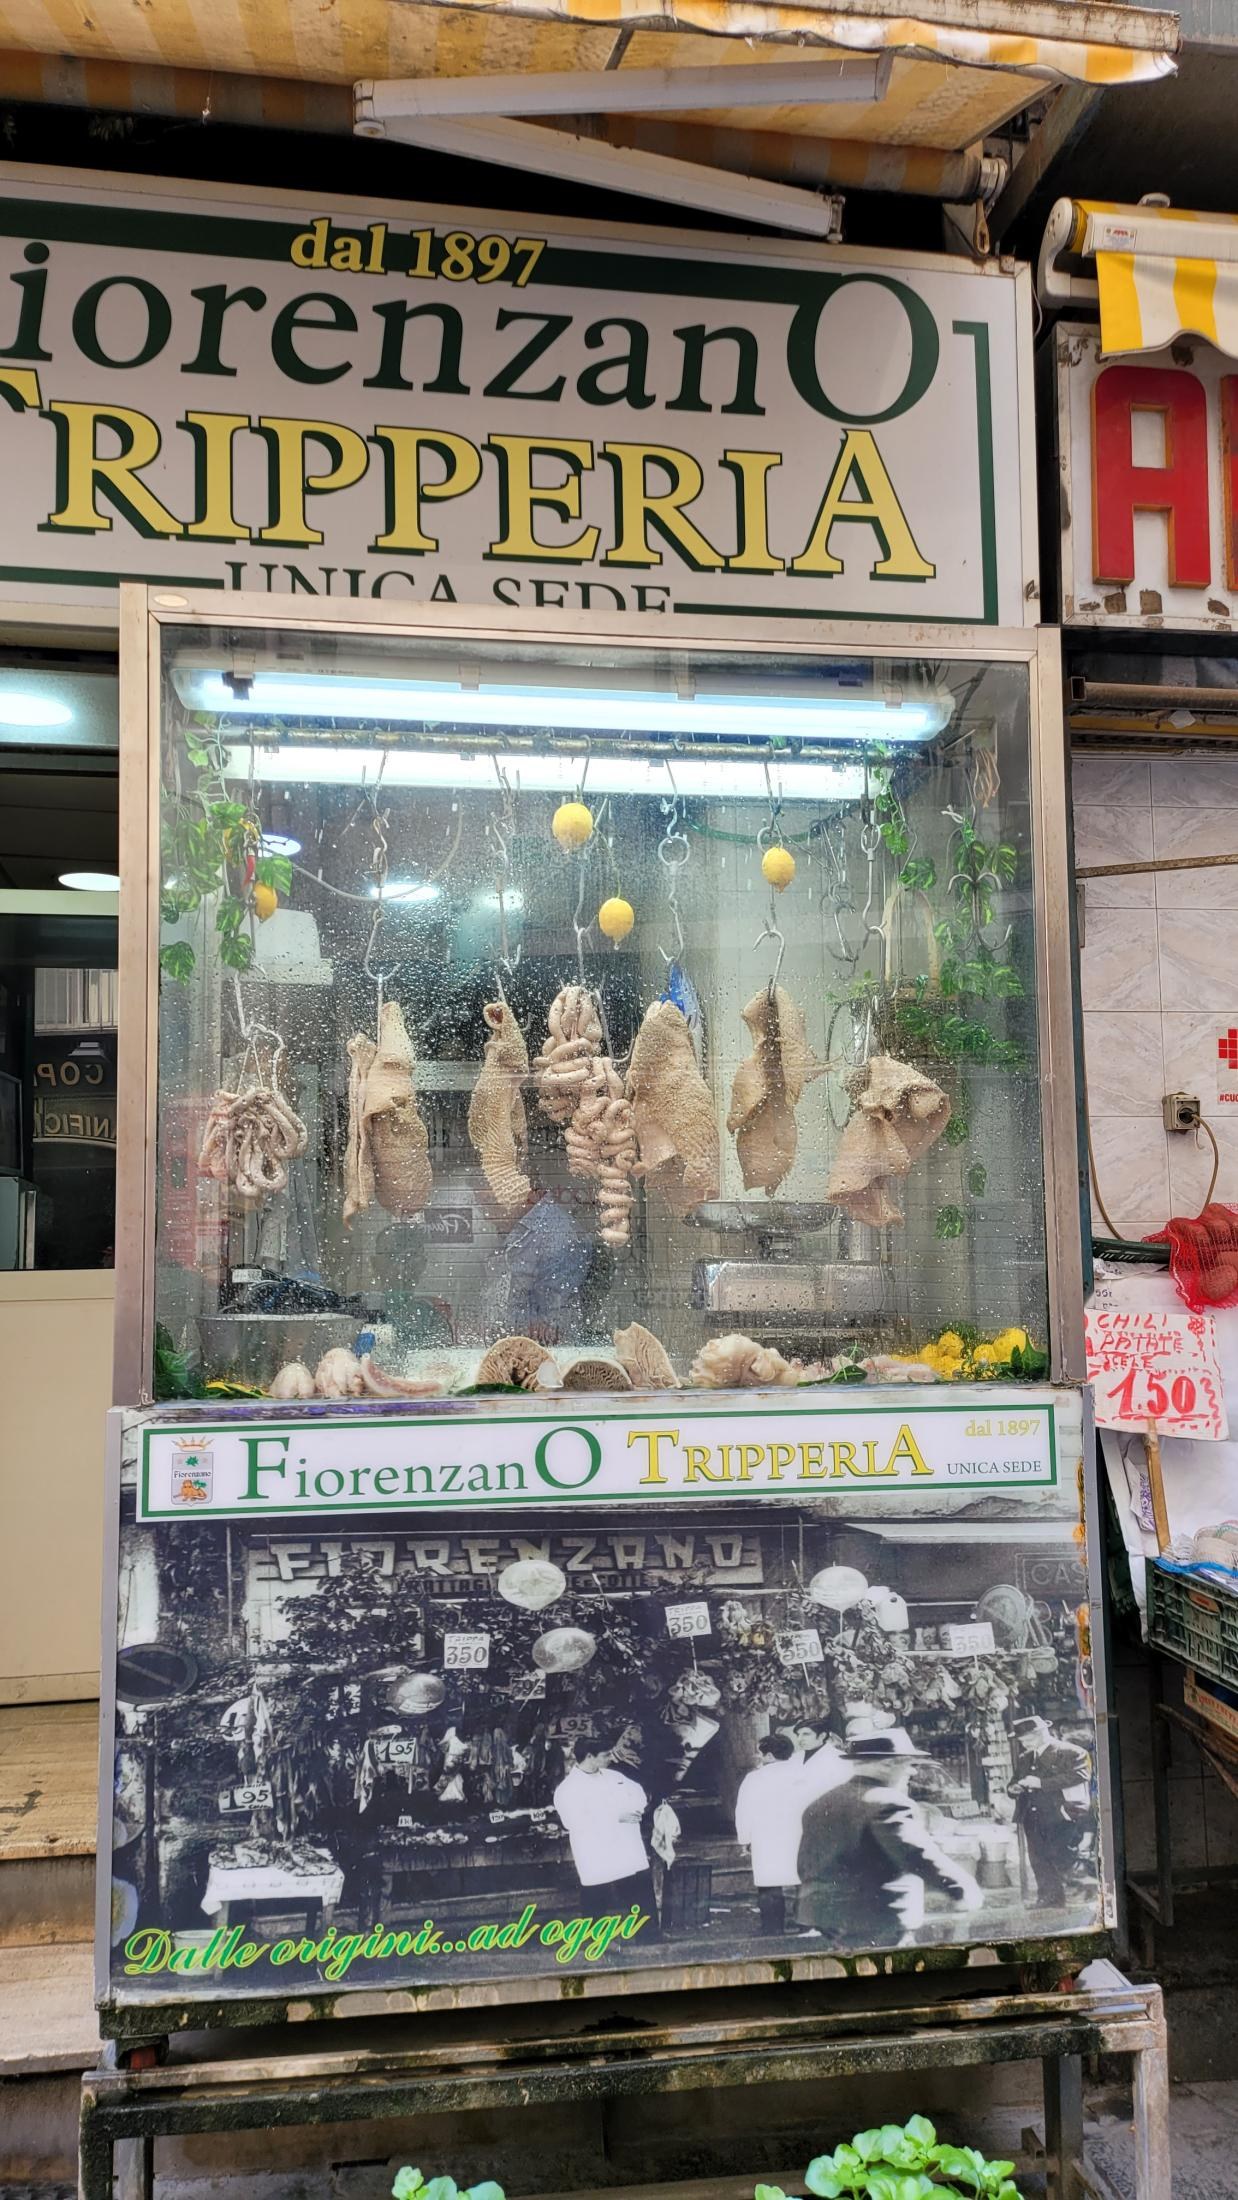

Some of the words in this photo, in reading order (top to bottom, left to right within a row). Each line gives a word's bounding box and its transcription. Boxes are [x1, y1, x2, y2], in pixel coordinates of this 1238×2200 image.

[290, 217, 389, 275] dal
[407, 228, 547, 288] 1897
[1106, 1369, 1197, 1417] 1.50
[965, 1419, 992, 1437] dal
[997, 1419, 1041, 1437] 1897
[237, 1426, 602, 1500] FiorenzanO
[627, 1423, 934, 1484] TRIPPERIA
[947, 1462, 1001, 1475] UNICA
[1002, 1460, 1043, 1473] SEDE
[668, 1614, 708, 1636] 350
[446, 1646, 488, 1665] 350
[123, 1924, 270, 1976] Dalle
[539, 1903, 651, 1965] oggi
